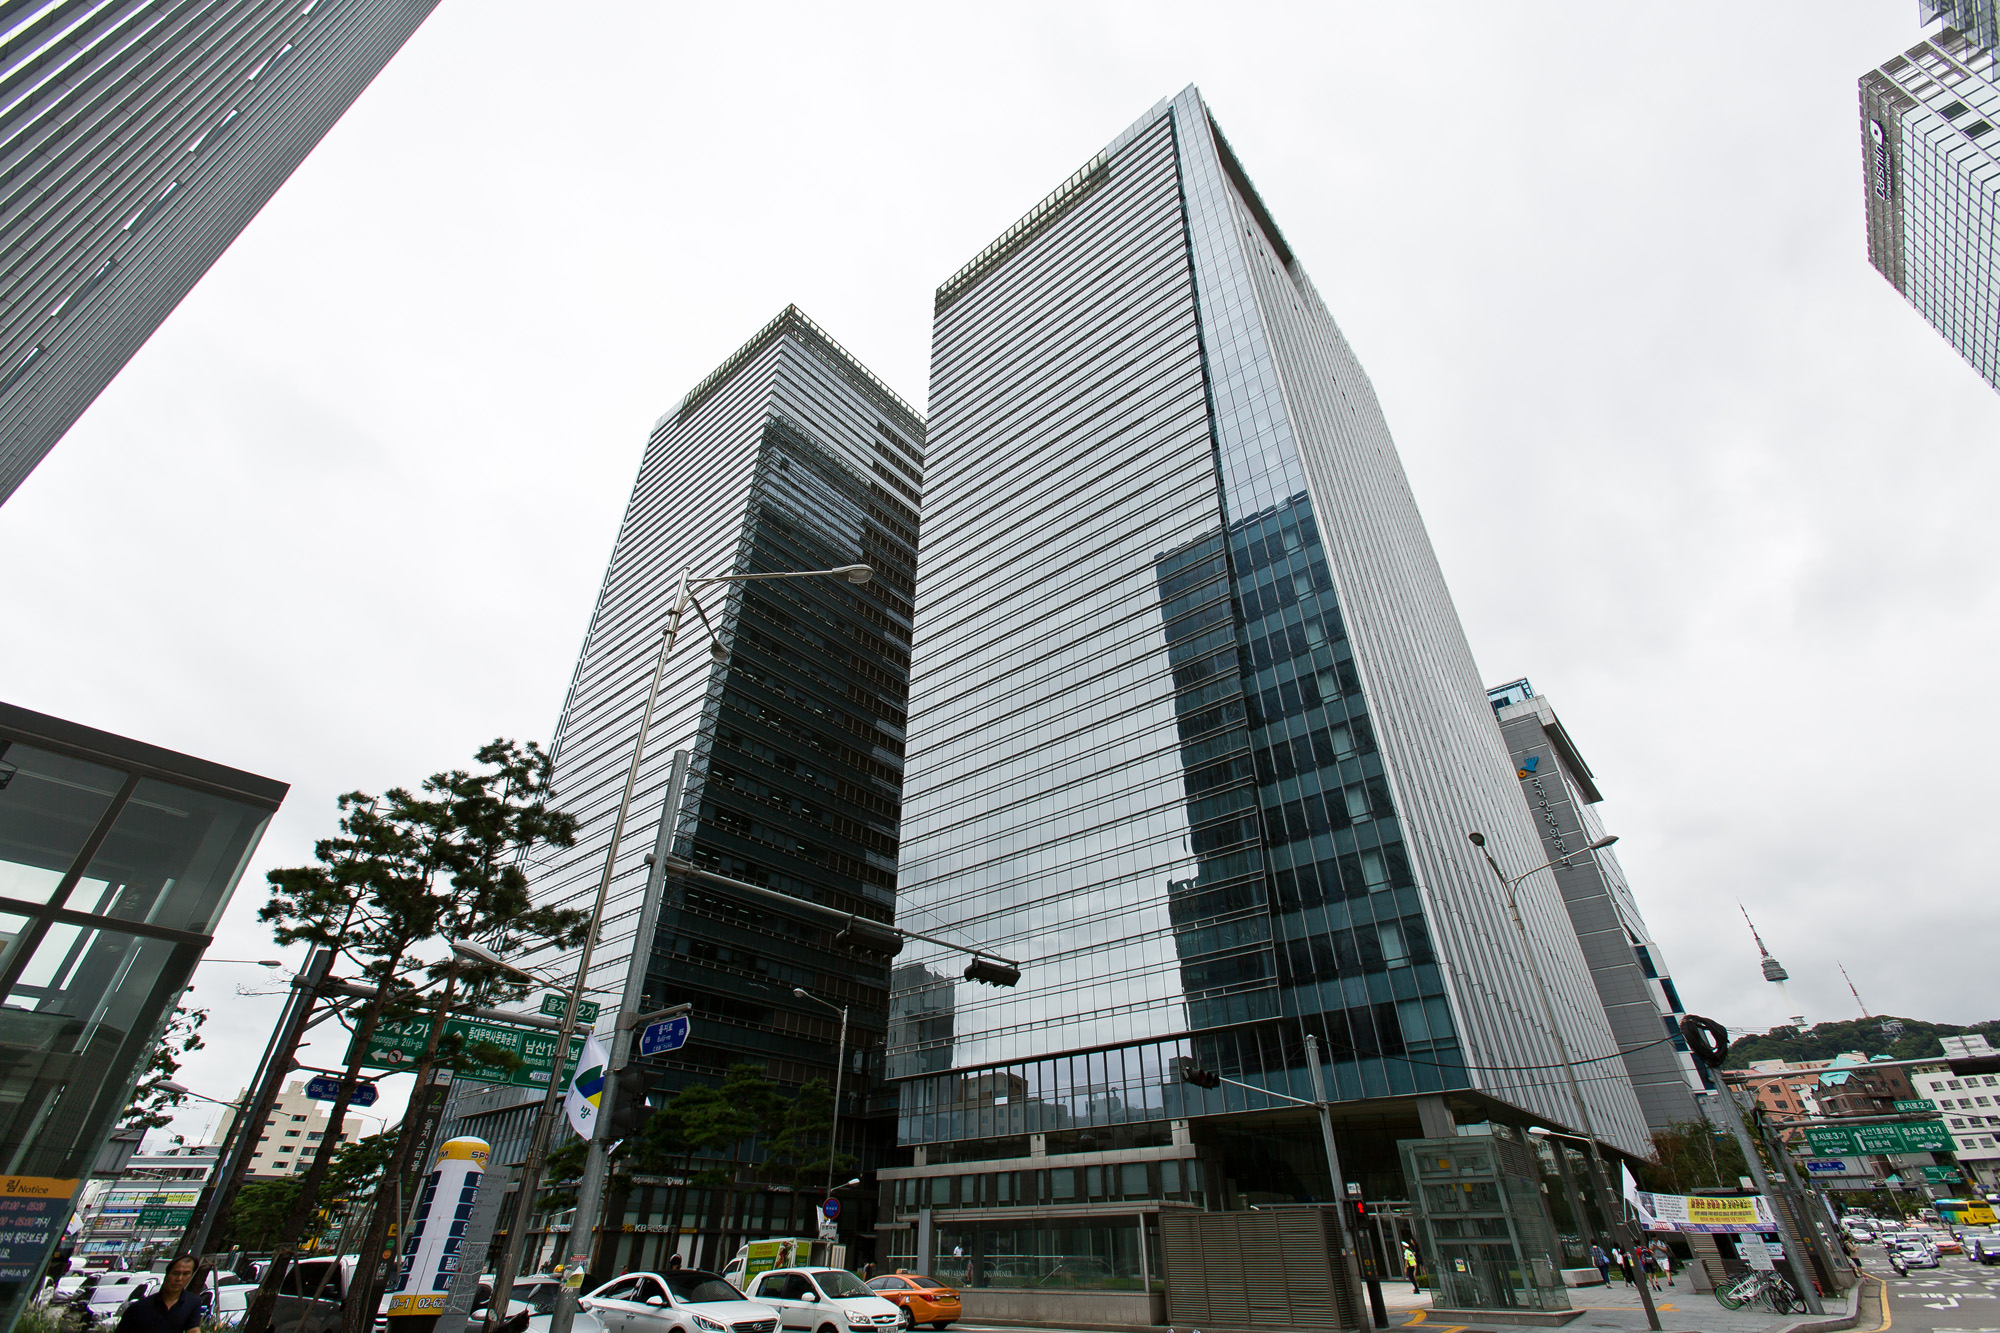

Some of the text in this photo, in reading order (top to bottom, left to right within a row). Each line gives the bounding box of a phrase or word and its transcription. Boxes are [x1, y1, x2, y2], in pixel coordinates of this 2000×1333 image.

[1875, 144, 1887, 200] Daishin
[547, 998, 595, 1019] 을지2가
[468, 1026, 519, 1047] 동대문역사문화공원
[310, 1083, 324, 1093] 356
[362, 1091, 374, 1101] 352
[432, 1091, 442, 1105] 2
[1897, 1101, 1934, 1111] 을지로2가
[1810, 1131, 1848, 1141] 을지로3가
[1901, 1125, 1943, 1136] 을지로1가
[410, 1118, 434, 1172] 을지스타몰
[1865, 1140, 1892, 1149] 명동역
[18, 1185, 49, 1194] Notice
